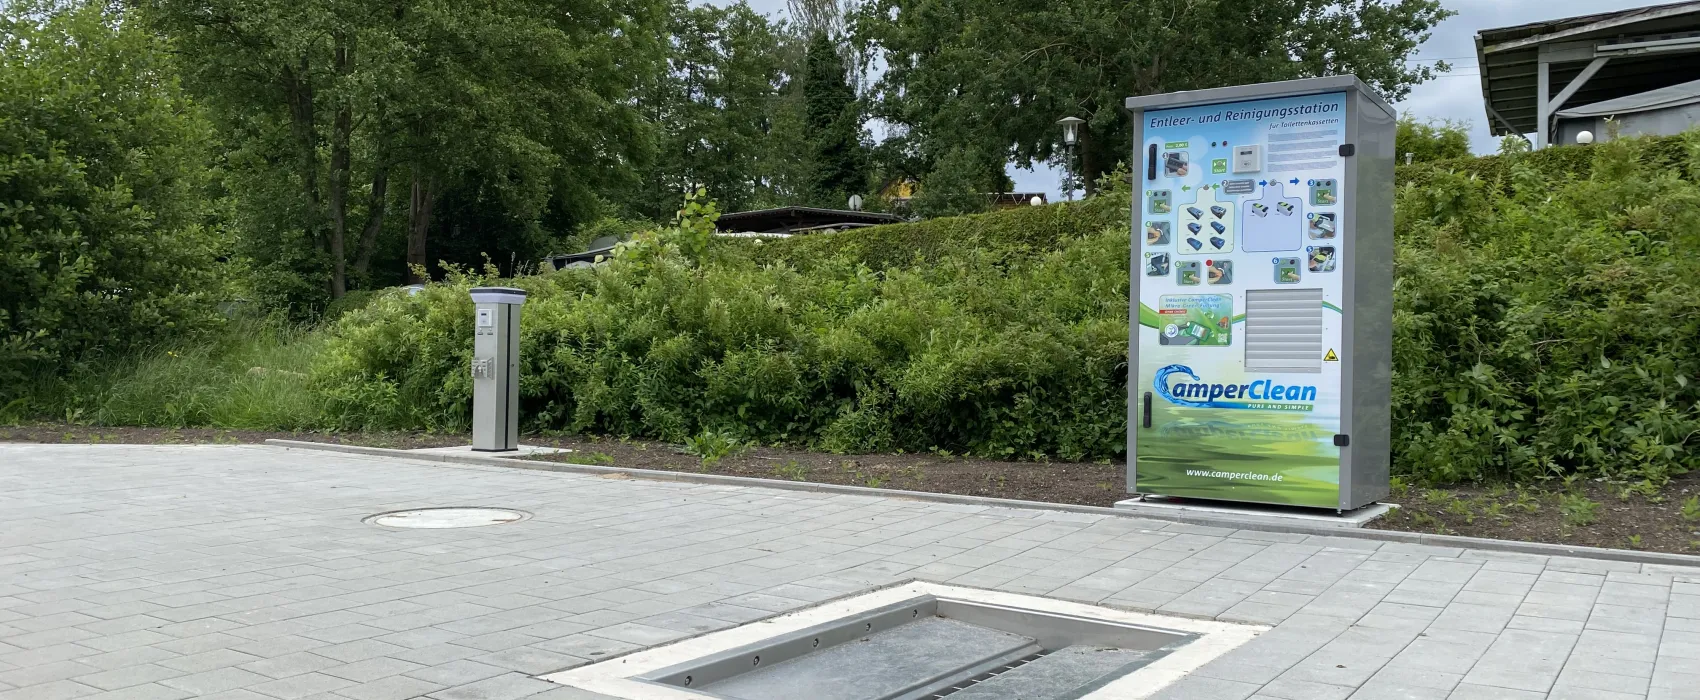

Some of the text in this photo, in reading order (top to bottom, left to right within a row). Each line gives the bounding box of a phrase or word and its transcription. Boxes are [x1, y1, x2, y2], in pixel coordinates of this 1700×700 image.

[1150, 102, 1339, 128] Entleer- und Reinigungsstation
[1281, 118, 1339, 128] Toilettenkassetten
[1154, 364, 1317, 409] CamperClean
[1186, 469, 1283, 482] www.camperclean.de
